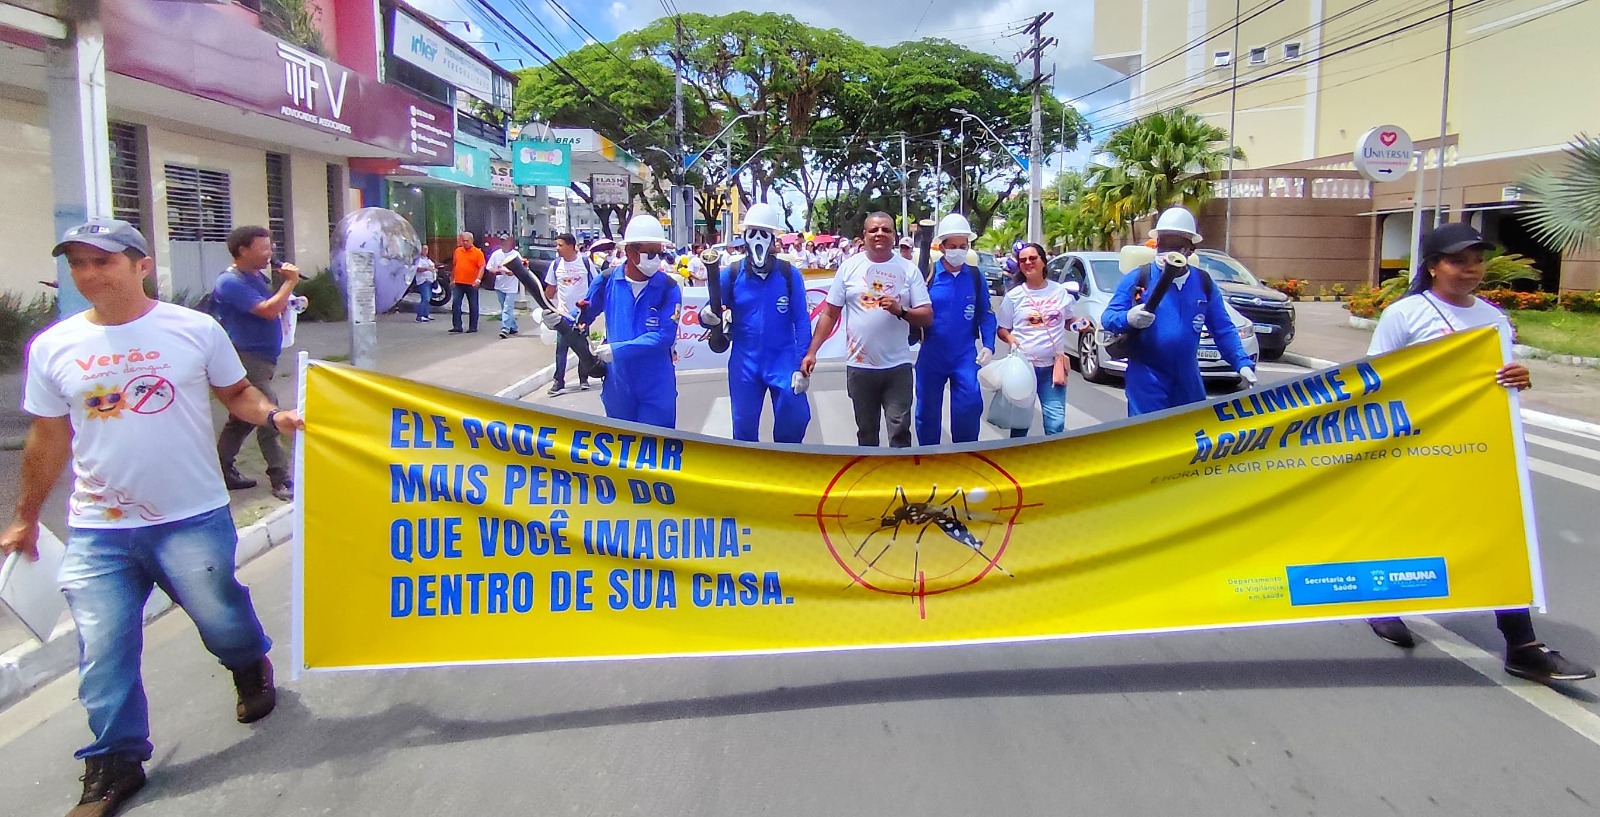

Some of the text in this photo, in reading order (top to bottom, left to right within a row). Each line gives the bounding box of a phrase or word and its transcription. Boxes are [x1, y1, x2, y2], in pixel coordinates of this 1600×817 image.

[281, 105, 352, 134] ADVOGADOS ASSOCIADOS
[1364, 147, 1409, 159] UNIVERSAL
[75, 348, 161, 371] Verão
[81, 363, 172, 381] sem dengue
[1212, 362, 1382, 422] ELIMINE A
[390, 408, 683, 472] ELE PODE ESTAR
[1190, 400, 1421, 465] ÁGUA PARADA.
[1162, 468, 1200, 482] HORA
[1204, 464, 1223, 476] DE
[1227, 461, 1262, 474] AGIR
[1266, 456, 1307, 471] PARA
[1310, 449, 1387, 467] COMBATER
[1391, 447, 1402, 458] O
[1407, 442, 1488, 457] MOSQUITO
[390, 463, 675, 506] MAIS PERTO DO
[390, 509, 752, 563] QUE VOCÊ IMAGINA:
[1228, 577, 1282, 586] Departamento
[1304, 574, 1356, 585] Secretaria da
[1332, 583, 1358, 591] Saúde
[1388, 570, 1437, 582] ITABUNA
[390, 568, 794, 618] DENTRO DE SUA CASA.
